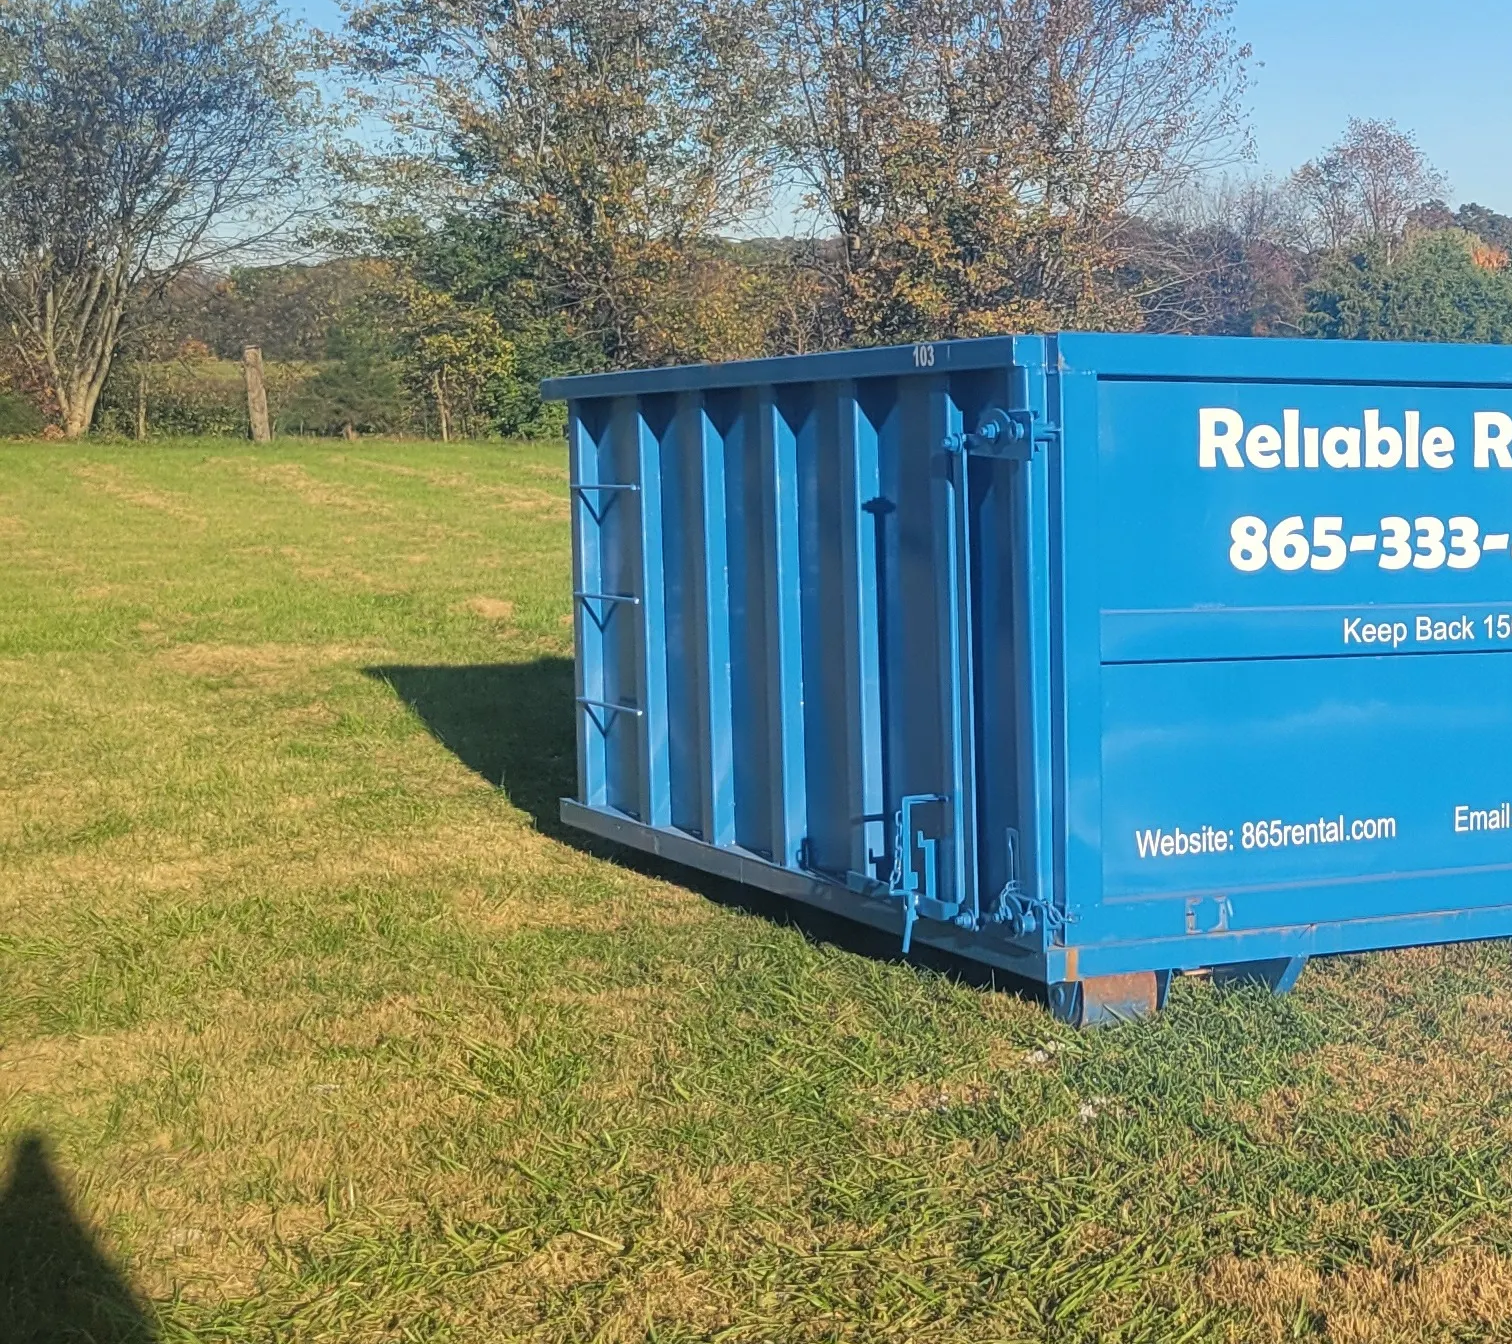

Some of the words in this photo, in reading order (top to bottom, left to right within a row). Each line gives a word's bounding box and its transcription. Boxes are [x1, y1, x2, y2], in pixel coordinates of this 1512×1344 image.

[912, 345, 935, 368] 103
[1198, 407, 1456, 469] Reliable
[1343, 617, 1408, 649] Keep
[1415, 615, 1475, 641] Back
[1135, 825, 1235, 859] Website:
[1241, 814, 1396, 851] 865rental.com
